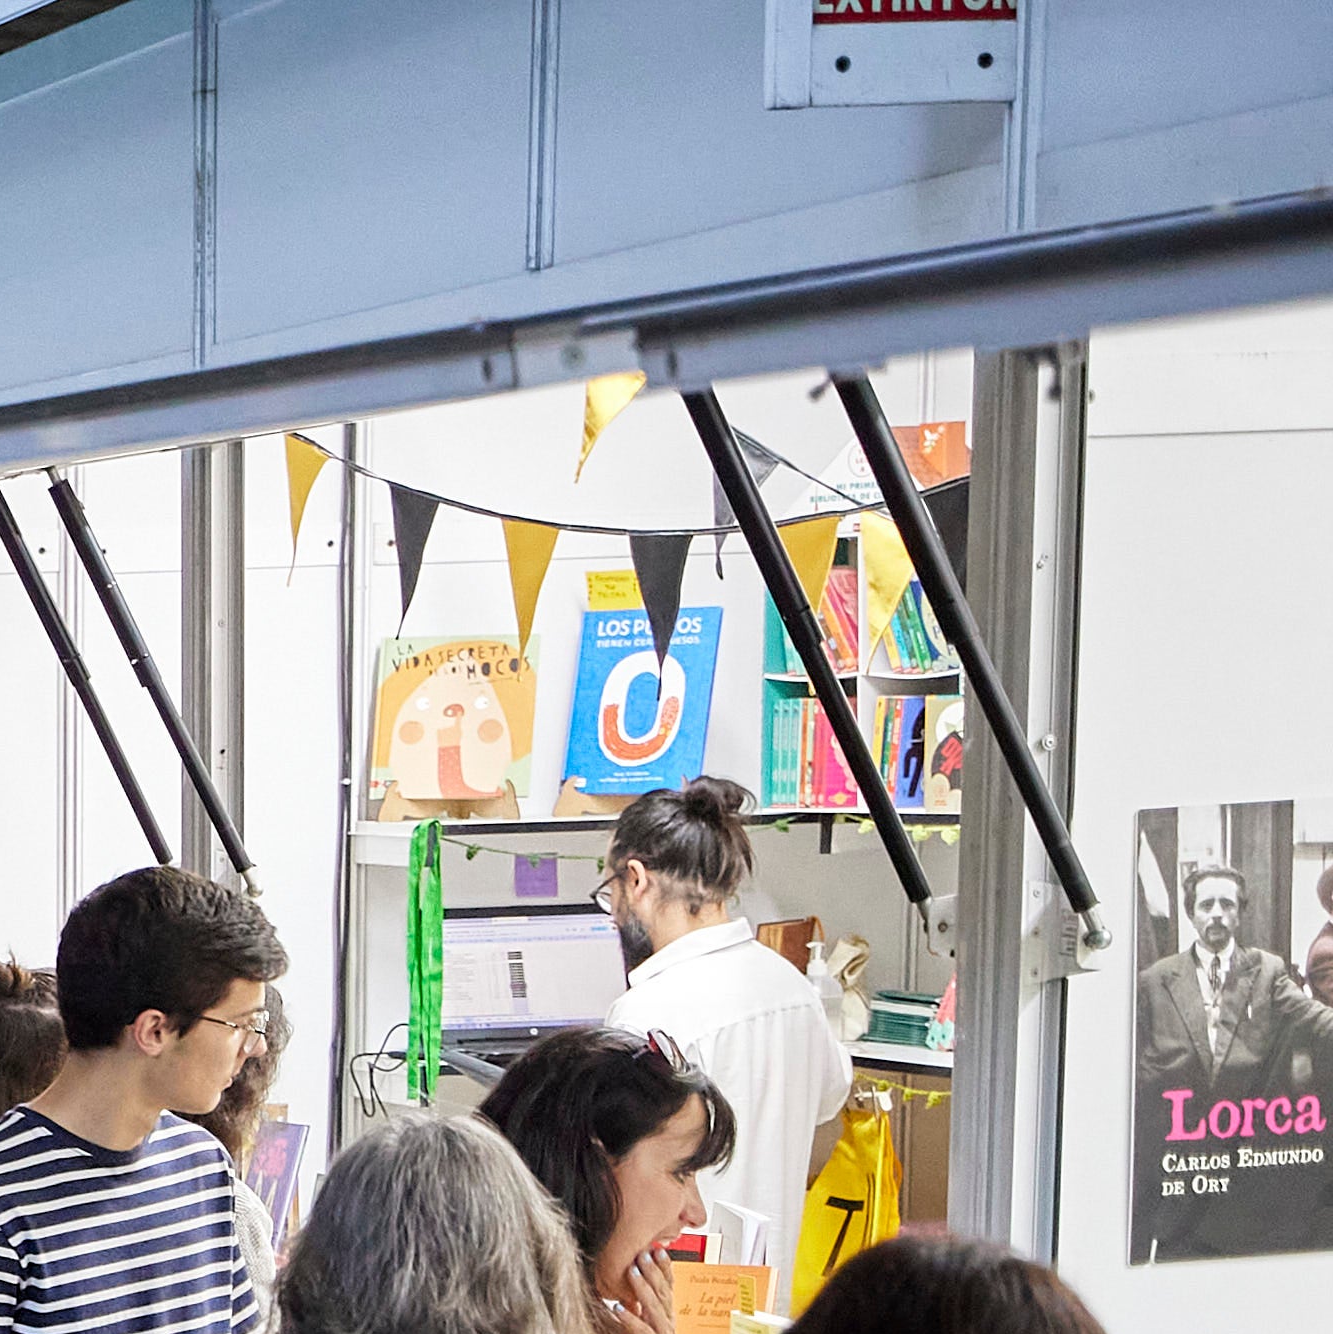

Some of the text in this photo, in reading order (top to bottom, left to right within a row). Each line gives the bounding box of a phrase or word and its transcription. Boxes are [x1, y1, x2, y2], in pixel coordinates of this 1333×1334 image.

[596, 618, 632, 637] LOS
[391, 643, 511, 673] VIDA SECRETA
[1161, 1088, 1328, 1142] Lorca
